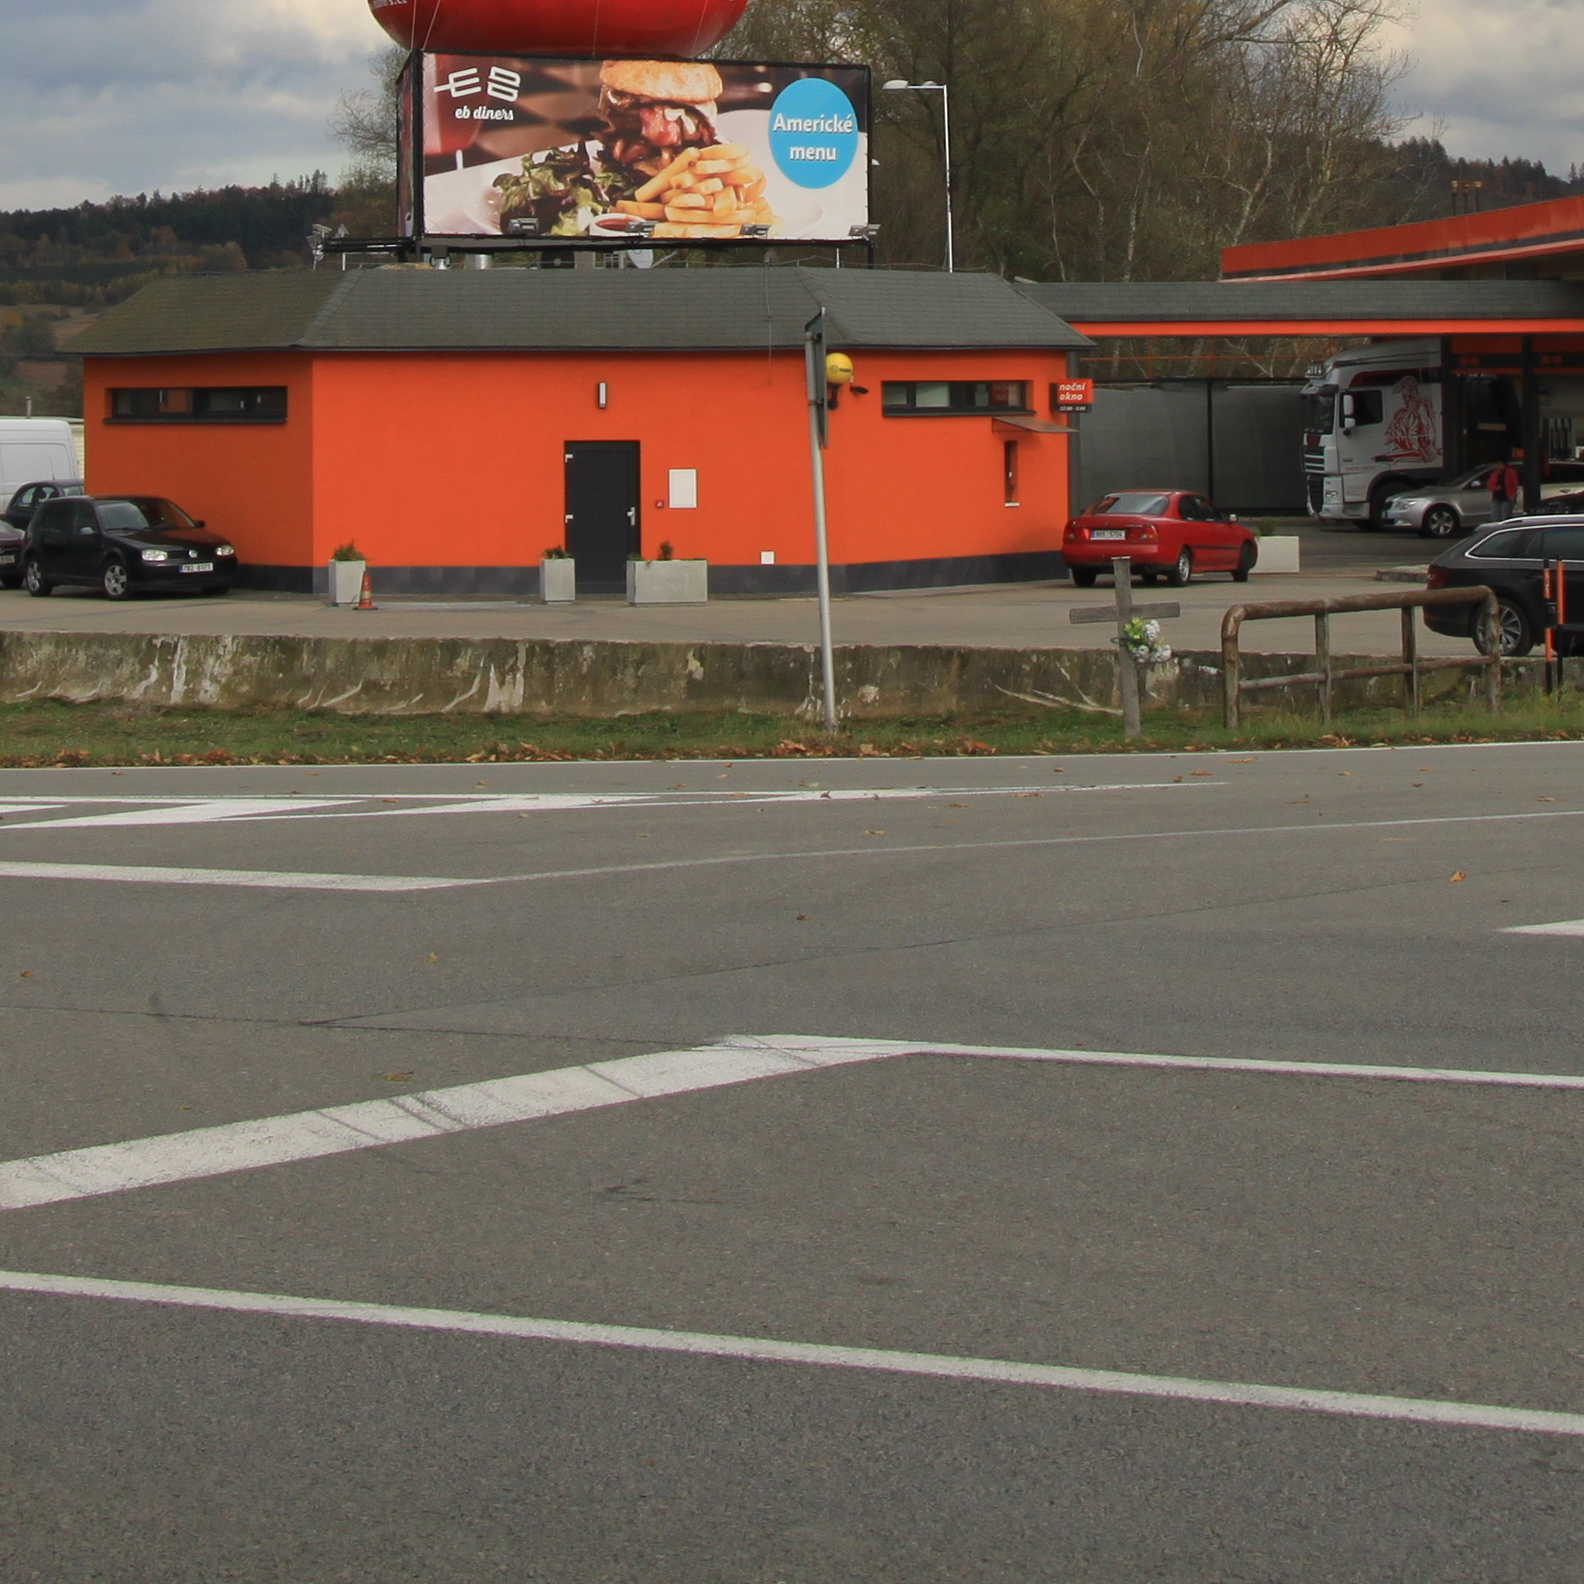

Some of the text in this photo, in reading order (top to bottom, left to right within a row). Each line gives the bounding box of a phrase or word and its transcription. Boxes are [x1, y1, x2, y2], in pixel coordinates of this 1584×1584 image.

[455, 105, 514, 120] eb diners
[773, 113, 853, 133] Americké
[790, 146, 837, 161] menu
[1059, 392, 1083, 401] okno
